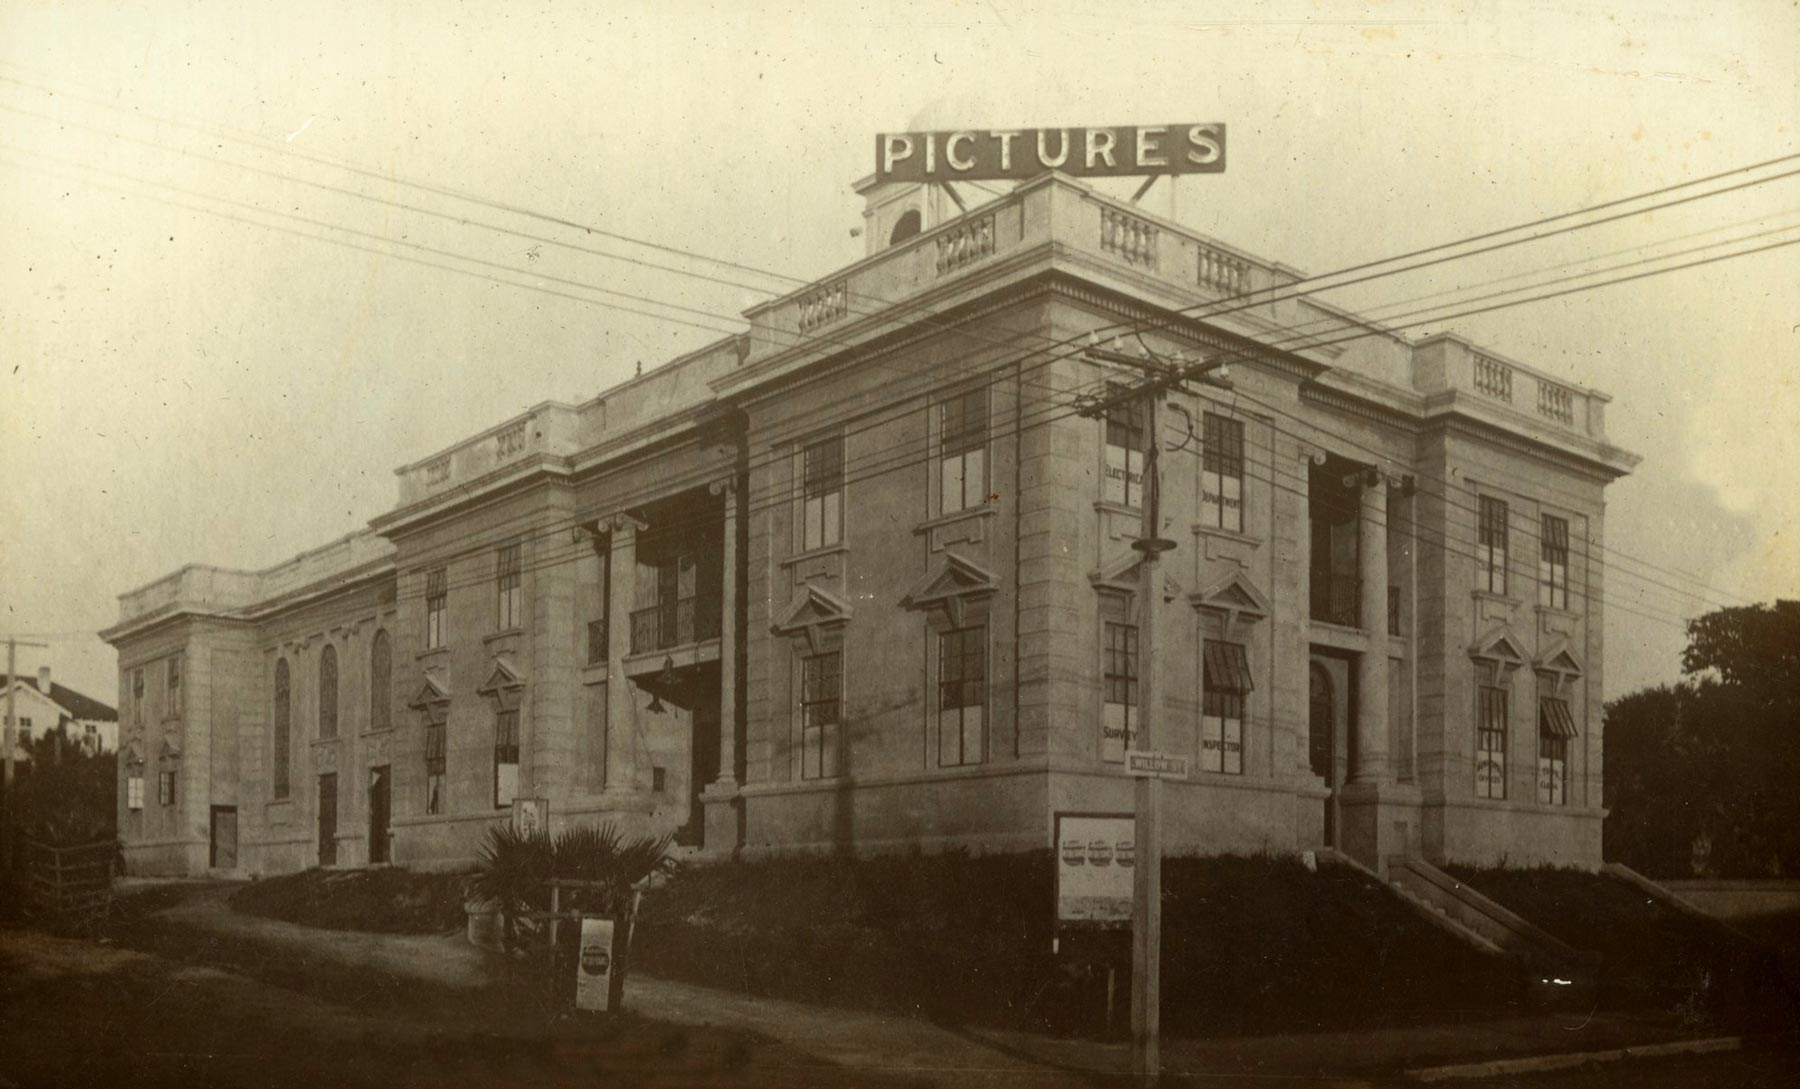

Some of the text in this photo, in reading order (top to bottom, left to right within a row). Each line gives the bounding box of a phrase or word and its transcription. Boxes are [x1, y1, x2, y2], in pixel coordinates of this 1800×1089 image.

[884, 124, 1222, 173] PICTURES
[1105, 464, 1144, 485] ELECTRICA
[1103, 726, 1139, 741] SURVEY
[1135, 758, 1168, 770] WILLOW
